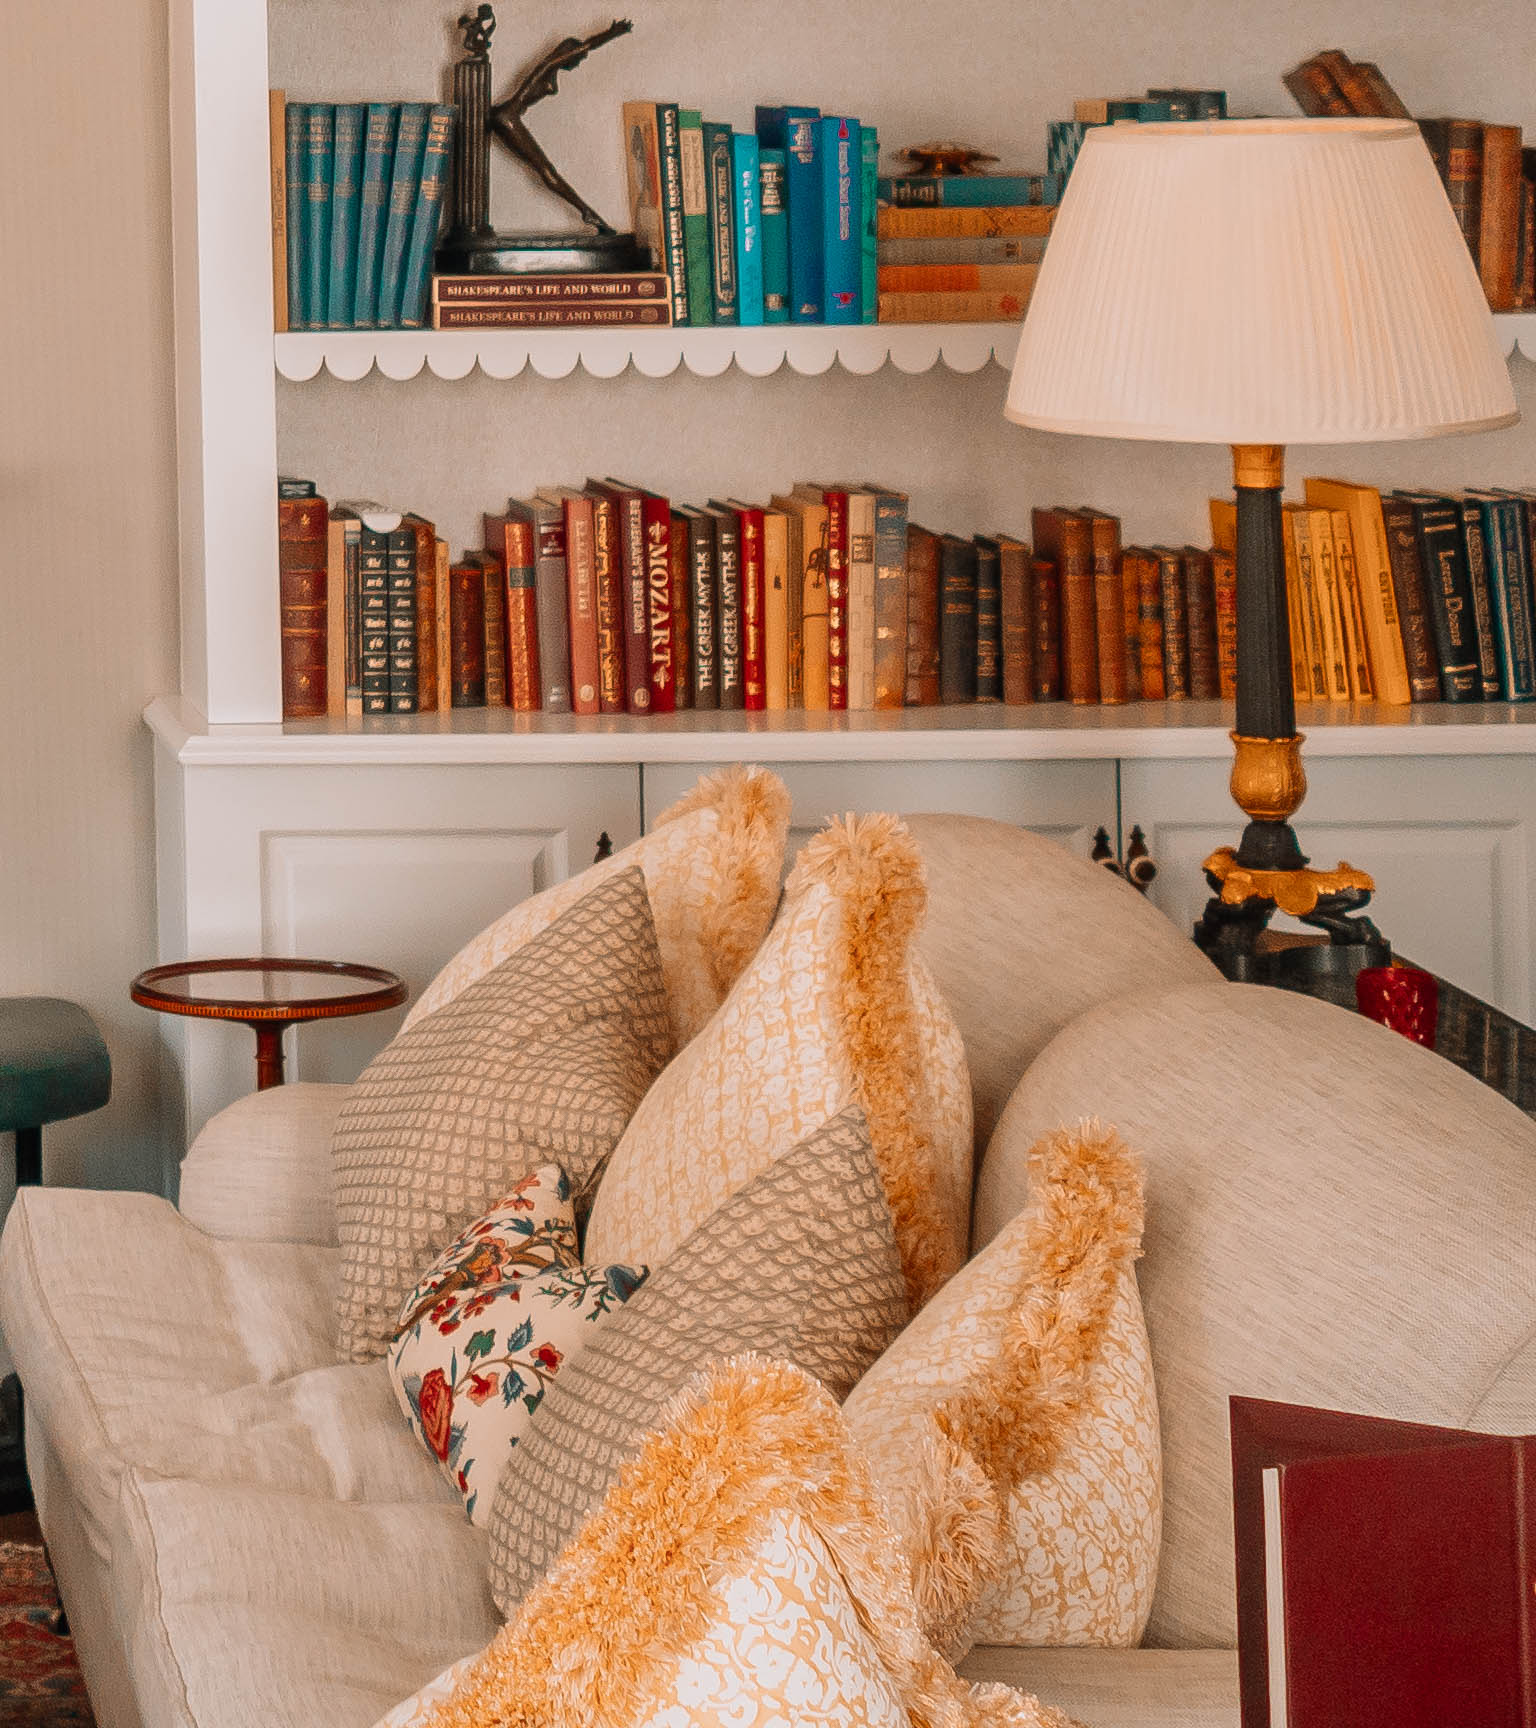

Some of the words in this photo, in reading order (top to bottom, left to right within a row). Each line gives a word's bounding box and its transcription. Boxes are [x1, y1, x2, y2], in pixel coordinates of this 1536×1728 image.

[447, 284, 533, 296] SHAKESPEARE'S
[535, 284, 561, 295] LIFE
[563, 284, 588, 295] AND
[591, 283, 631, 294] WORLD
[450, 311, 536, 322] SHAKESPEARE'S
[538, 311, 563, 322] LIFE
[566, 311, 591, 322] AND
[593, 310, 634, 321] WORLD
[696, 552, 712, 606] MYTHS
[722, 552, 738, 606] MYTHS
[649, 543, 670, 666] MOZART
[696, 608, 712, 656] GREEK
[723, 608, 738, 654] GREEK
[696, 658, 712, 690] THE
[724, 657, 739, 690] THE
